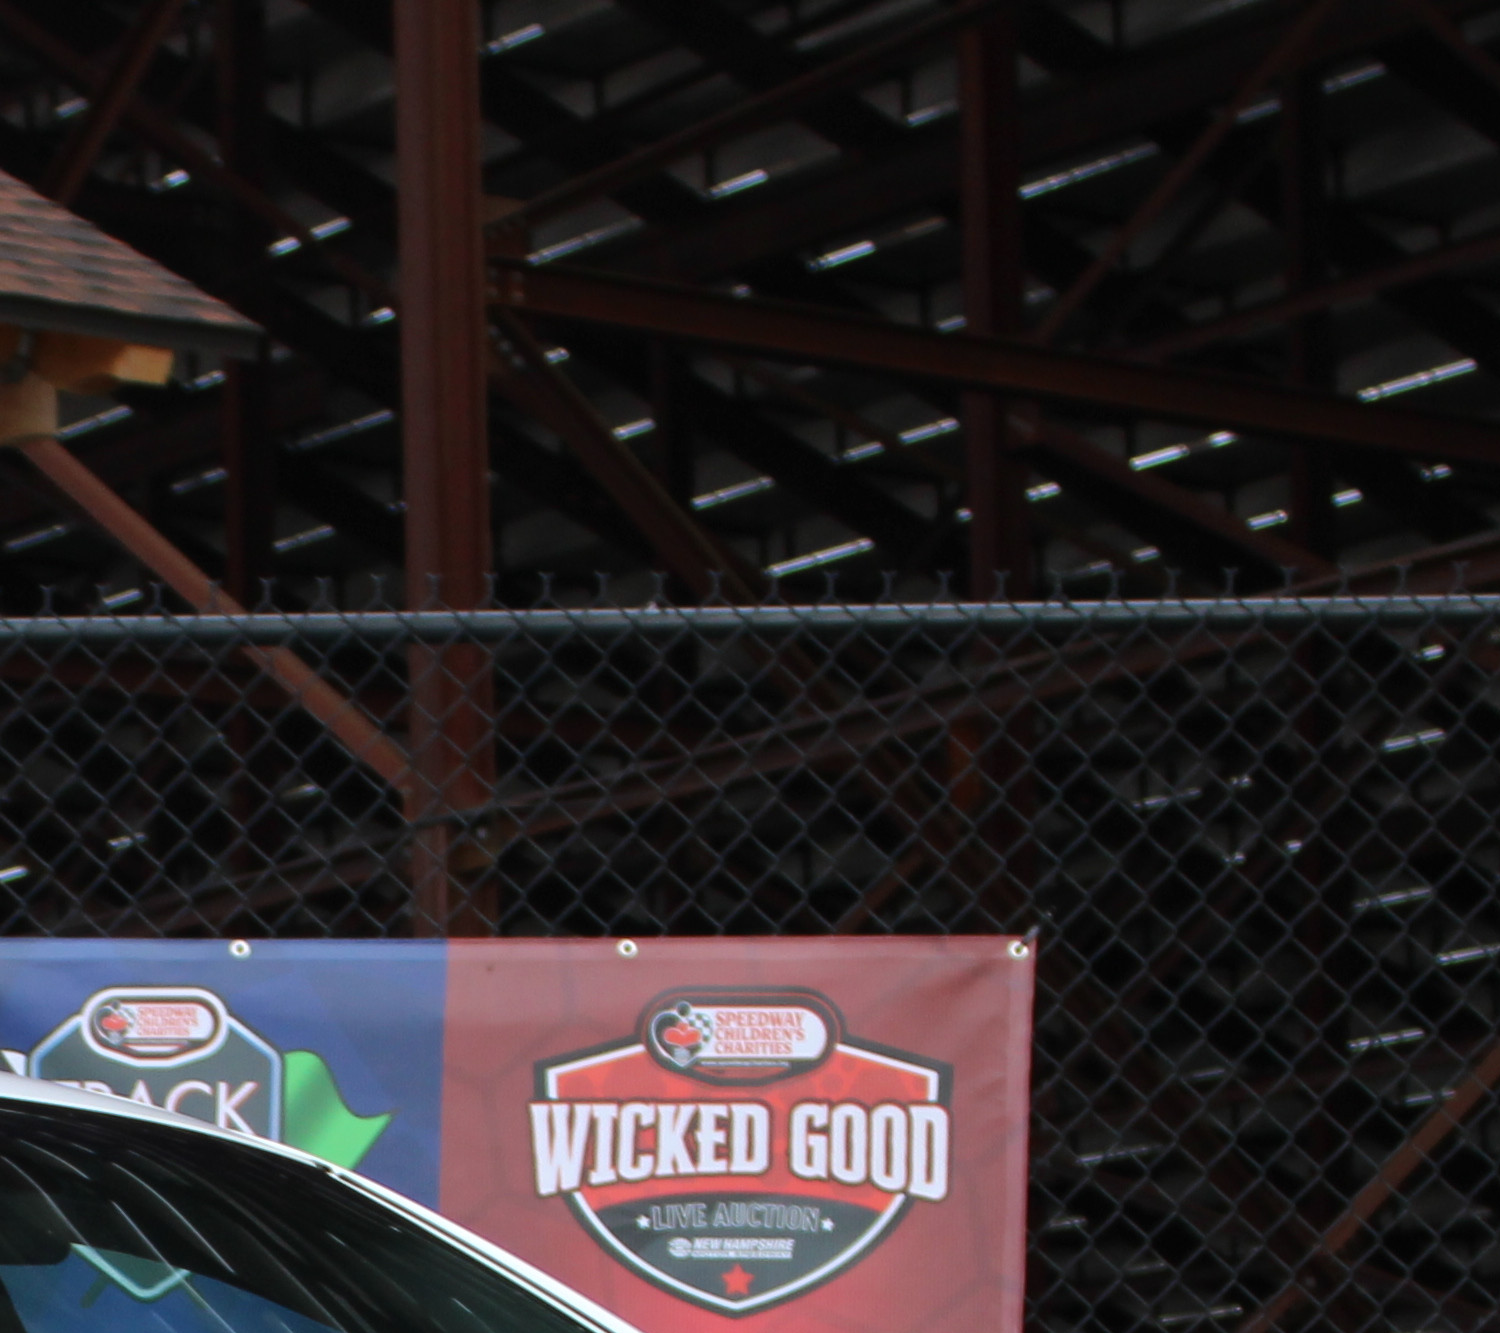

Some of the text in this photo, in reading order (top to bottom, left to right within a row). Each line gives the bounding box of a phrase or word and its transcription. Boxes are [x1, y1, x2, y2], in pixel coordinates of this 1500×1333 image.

[714, 1011, 804, 1027] SPEEDWAY
[714, 1027, 806, 1041] CHILDREN'S
[714, 1041, 794, 1055] CHARITIES
[528, 1101, 950, 1202] WICKED GOOD
[651, 1202, 821, 1232] LIVE AUCTION
[691, 1238, 796, 1251] NEW HAMPSHIRE
